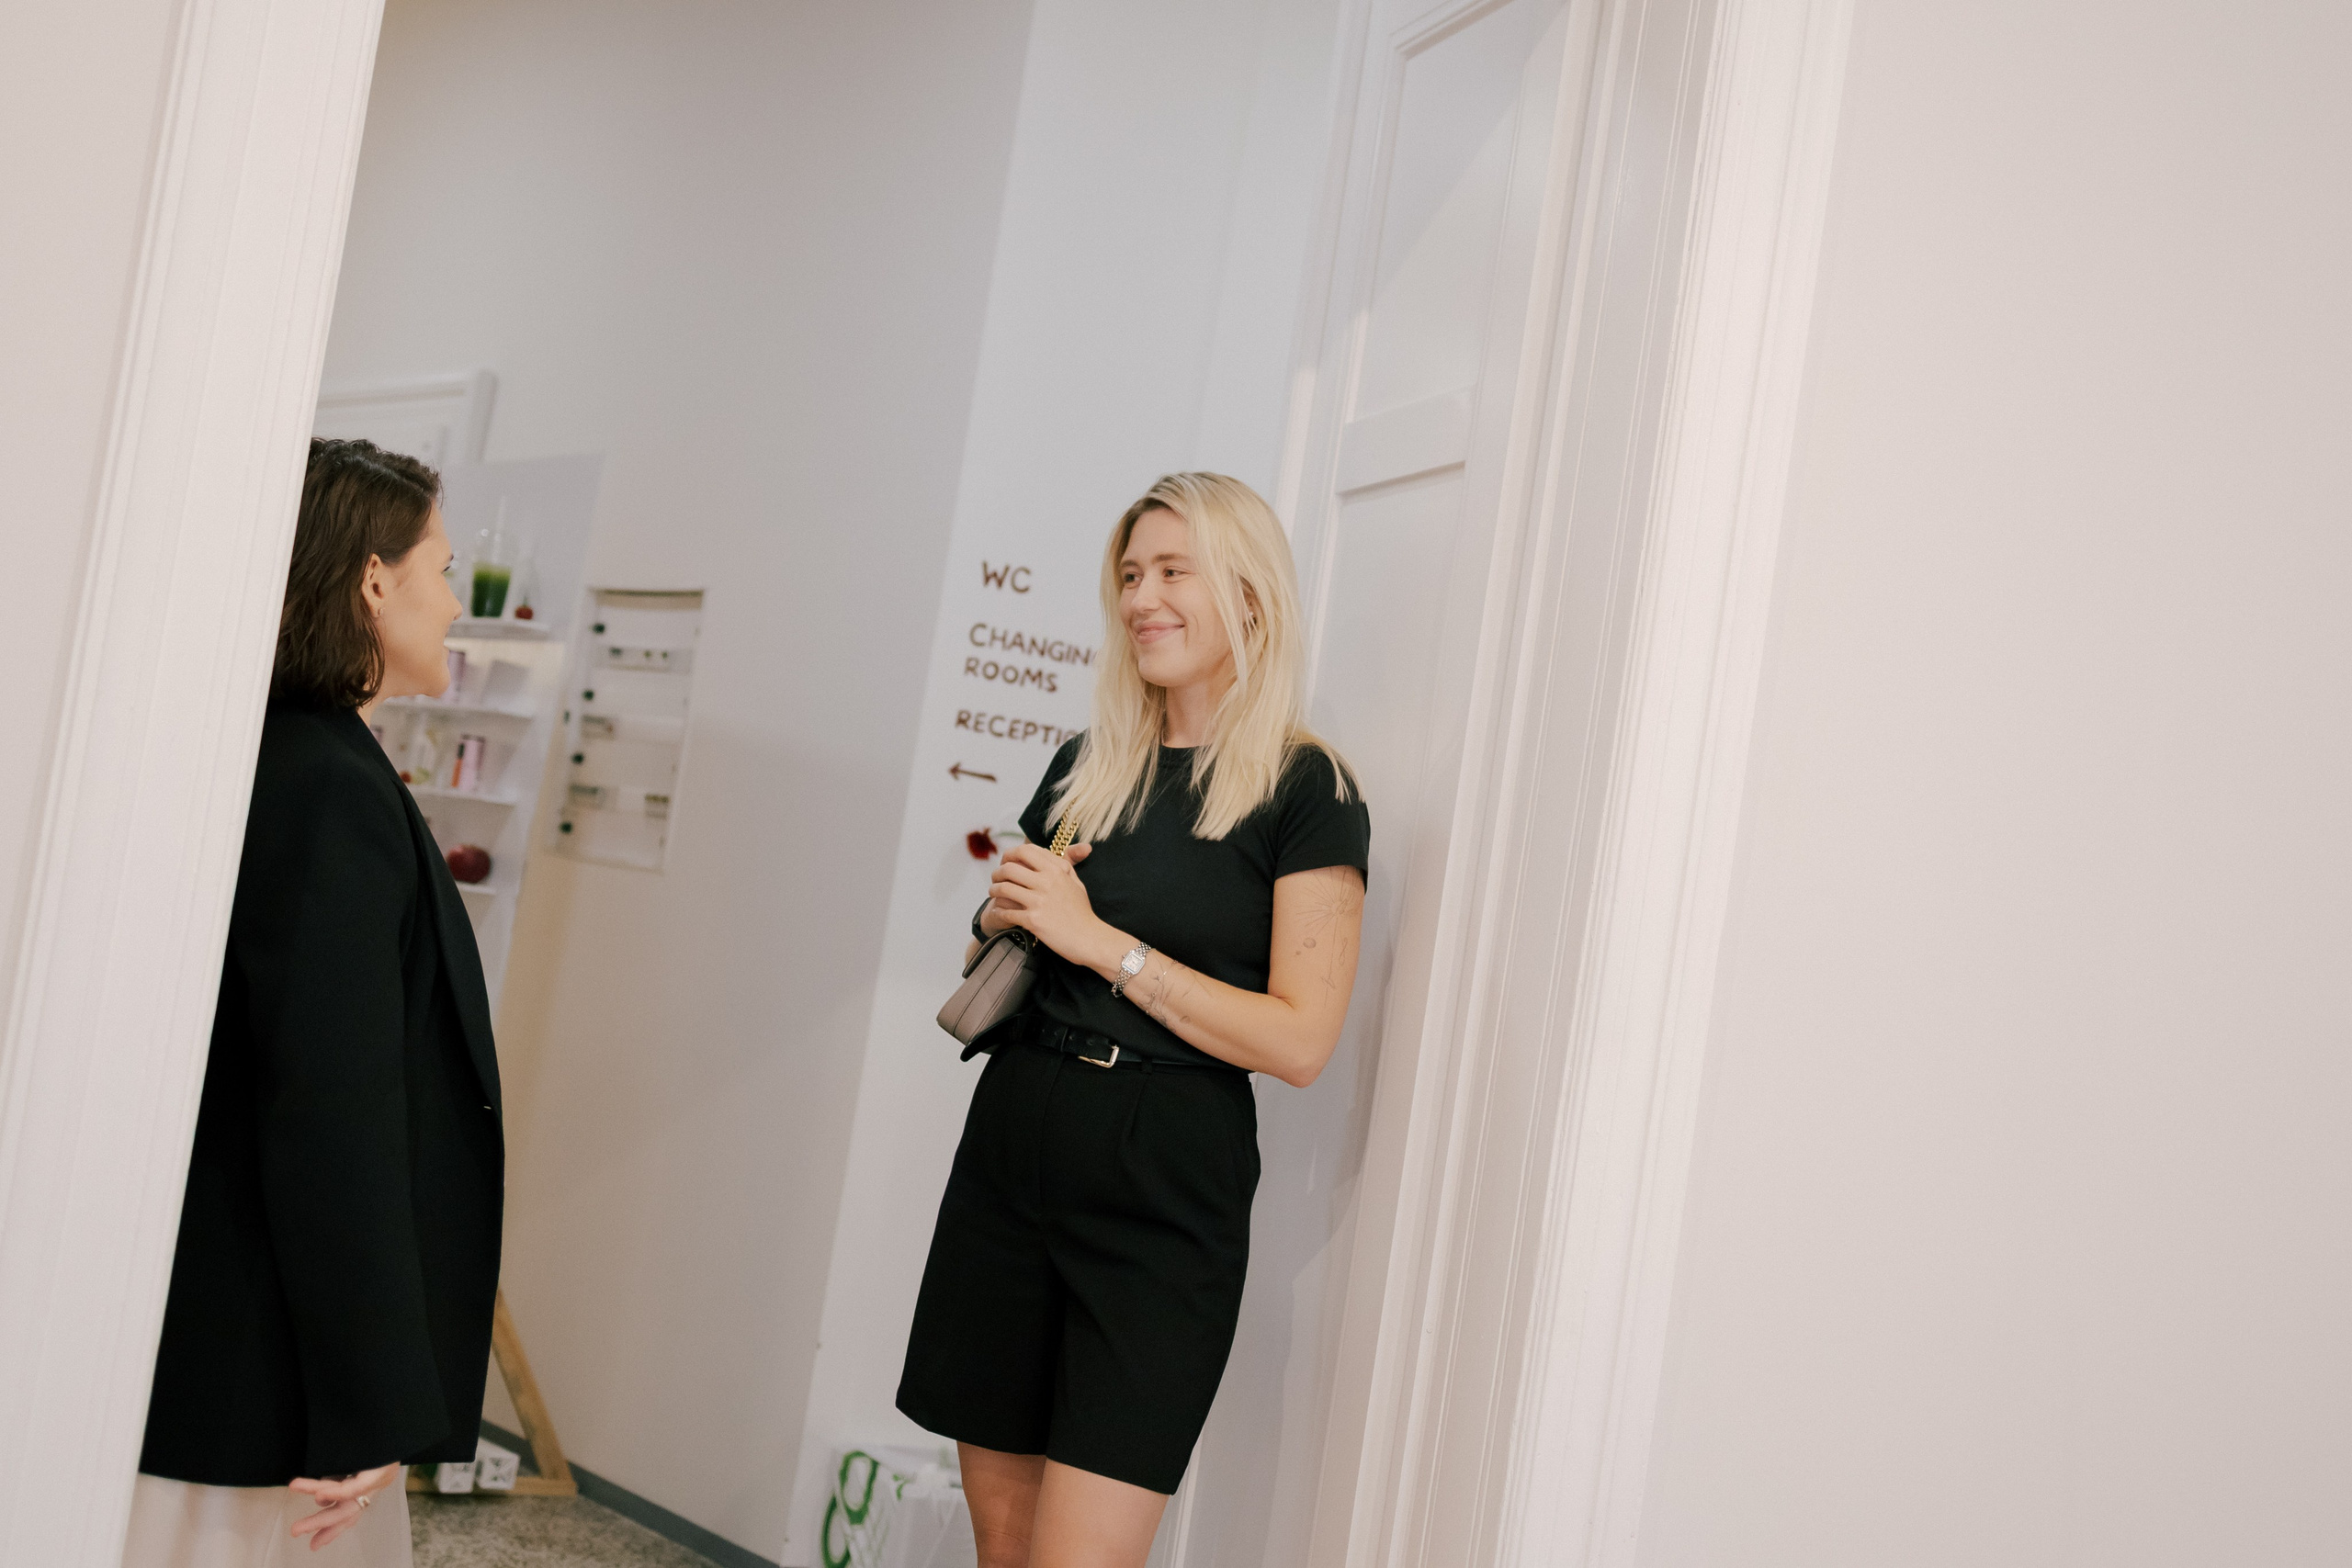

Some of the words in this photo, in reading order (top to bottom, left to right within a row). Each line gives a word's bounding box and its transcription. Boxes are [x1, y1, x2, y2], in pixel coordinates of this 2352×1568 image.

[983, 562, 1031, 593] WC
[970, 624, 1097, 666] CHANGIN
[965, 658, 1057, 693] ROOMS
